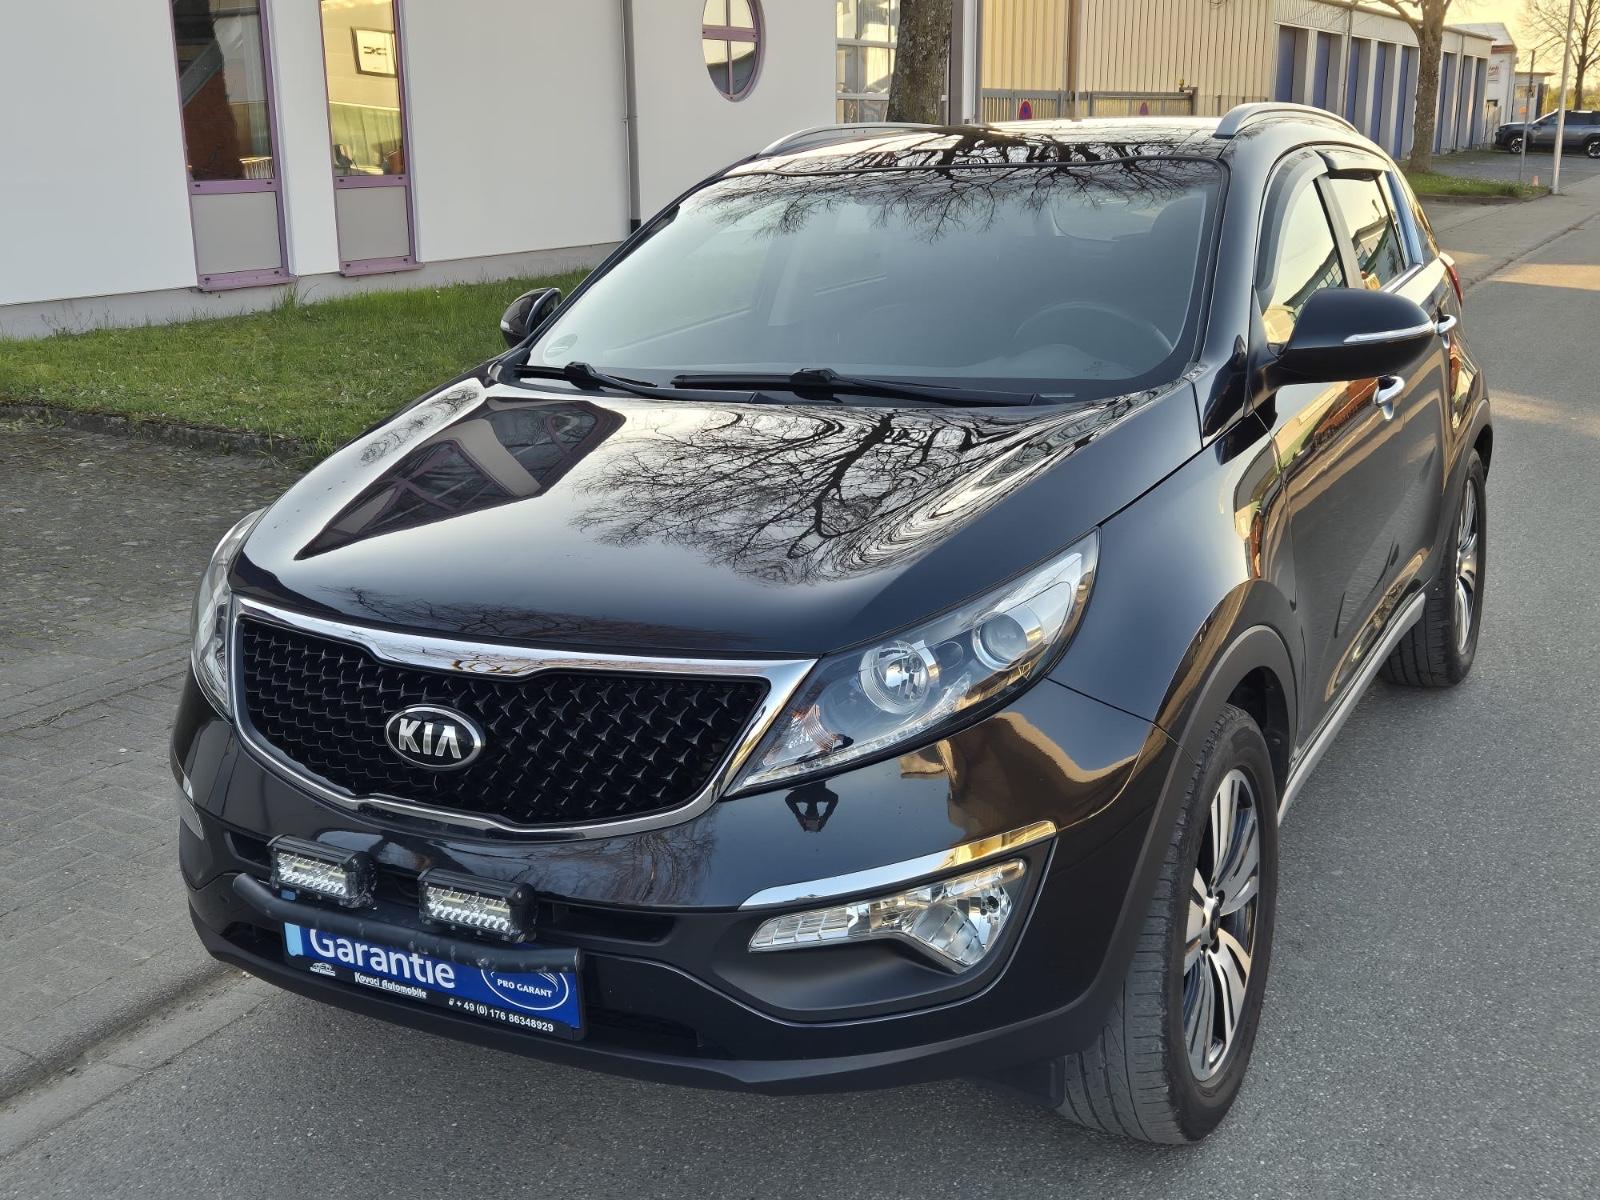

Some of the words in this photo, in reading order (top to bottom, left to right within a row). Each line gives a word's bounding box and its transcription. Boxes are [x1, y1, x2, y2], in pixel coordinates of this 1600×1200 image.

[398, 718, 462, 759] KIA
[309, 929, 456, 989] Garantie
[382, 980, 427, 999] Automobile
[497, 978, 515, 989] PRO
[516, 984, 553, 998] GARANT
[463, 1001, 475, 1012] 49
[476, 1003, 488, 1016] (0)
[489, 1009, 506, 1021] 176
[508, 1014, 554, 1032] 86348929
